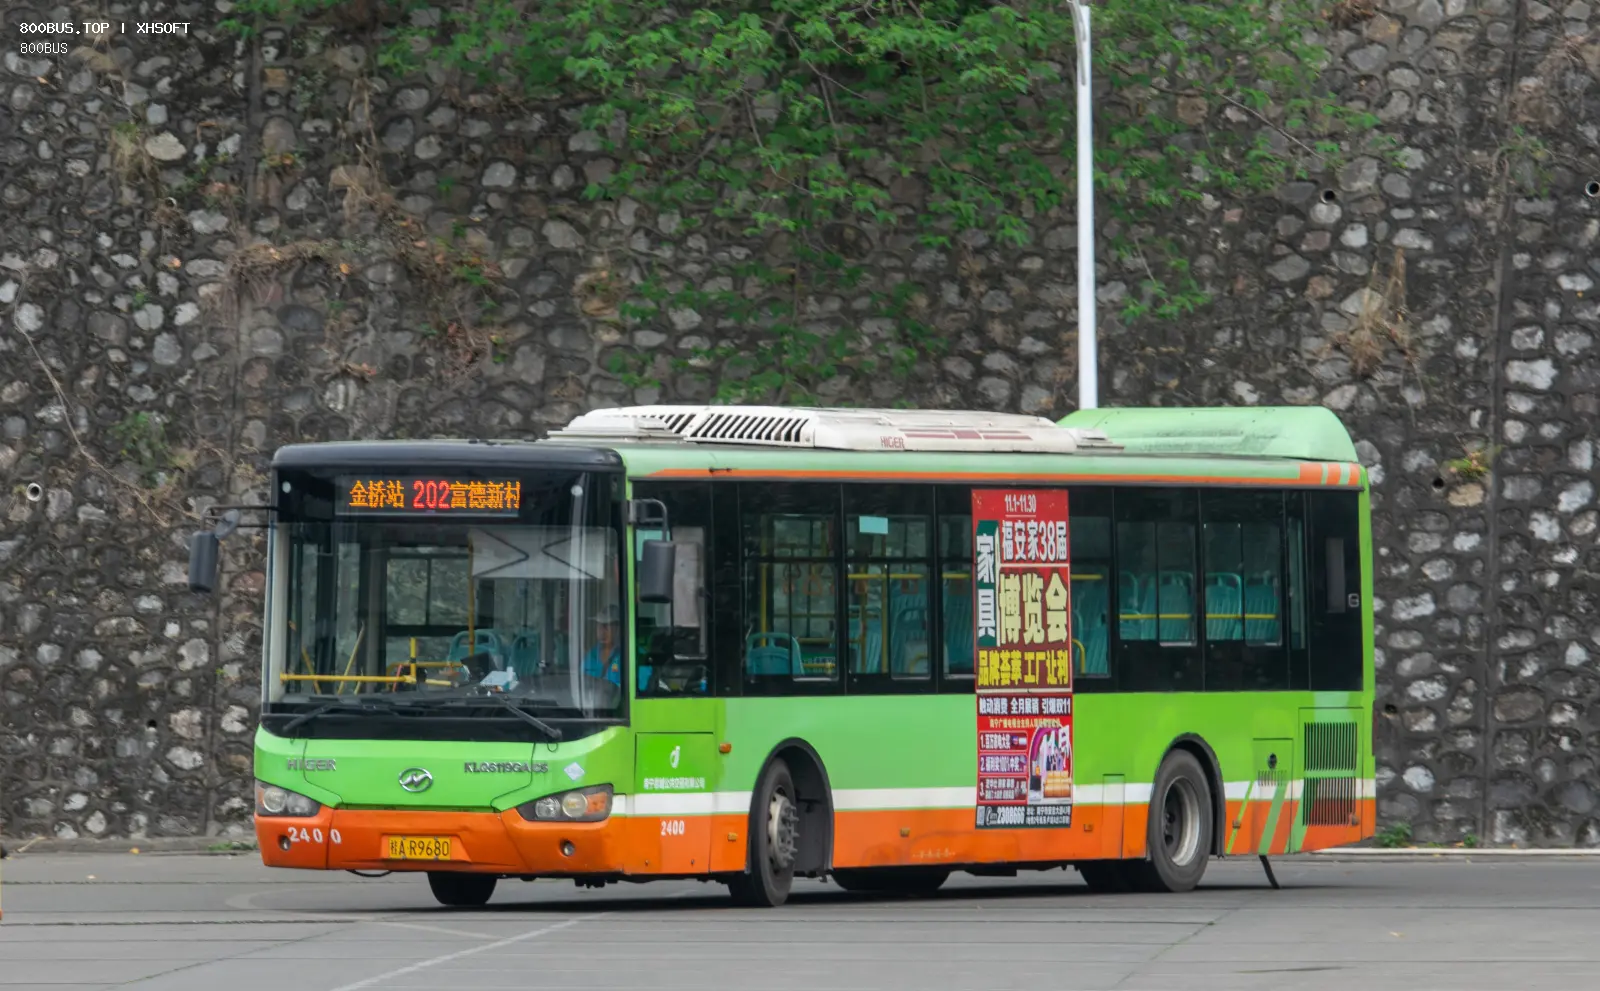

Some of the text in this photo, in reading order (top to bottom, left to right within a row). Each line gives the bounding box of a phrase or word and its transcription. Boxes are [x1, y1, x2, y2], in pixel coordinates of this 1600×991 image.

[880, 436, 905, 449] HIGER
[349, 480, 520, 509] 金桥站 202 富德新村
[1002, 520, 1067, 561] 福安家38届
[976, 533, 996, 638] 家具
[1000, 573, 1068, 645] 博览会
[978, 649, 1069, 686] 品牌荟萃 工厂让利
[287, 757, 337, 771] HIGER
[288, 826, 342, 844] 2400
[661, 820, 685, 836] 2400
